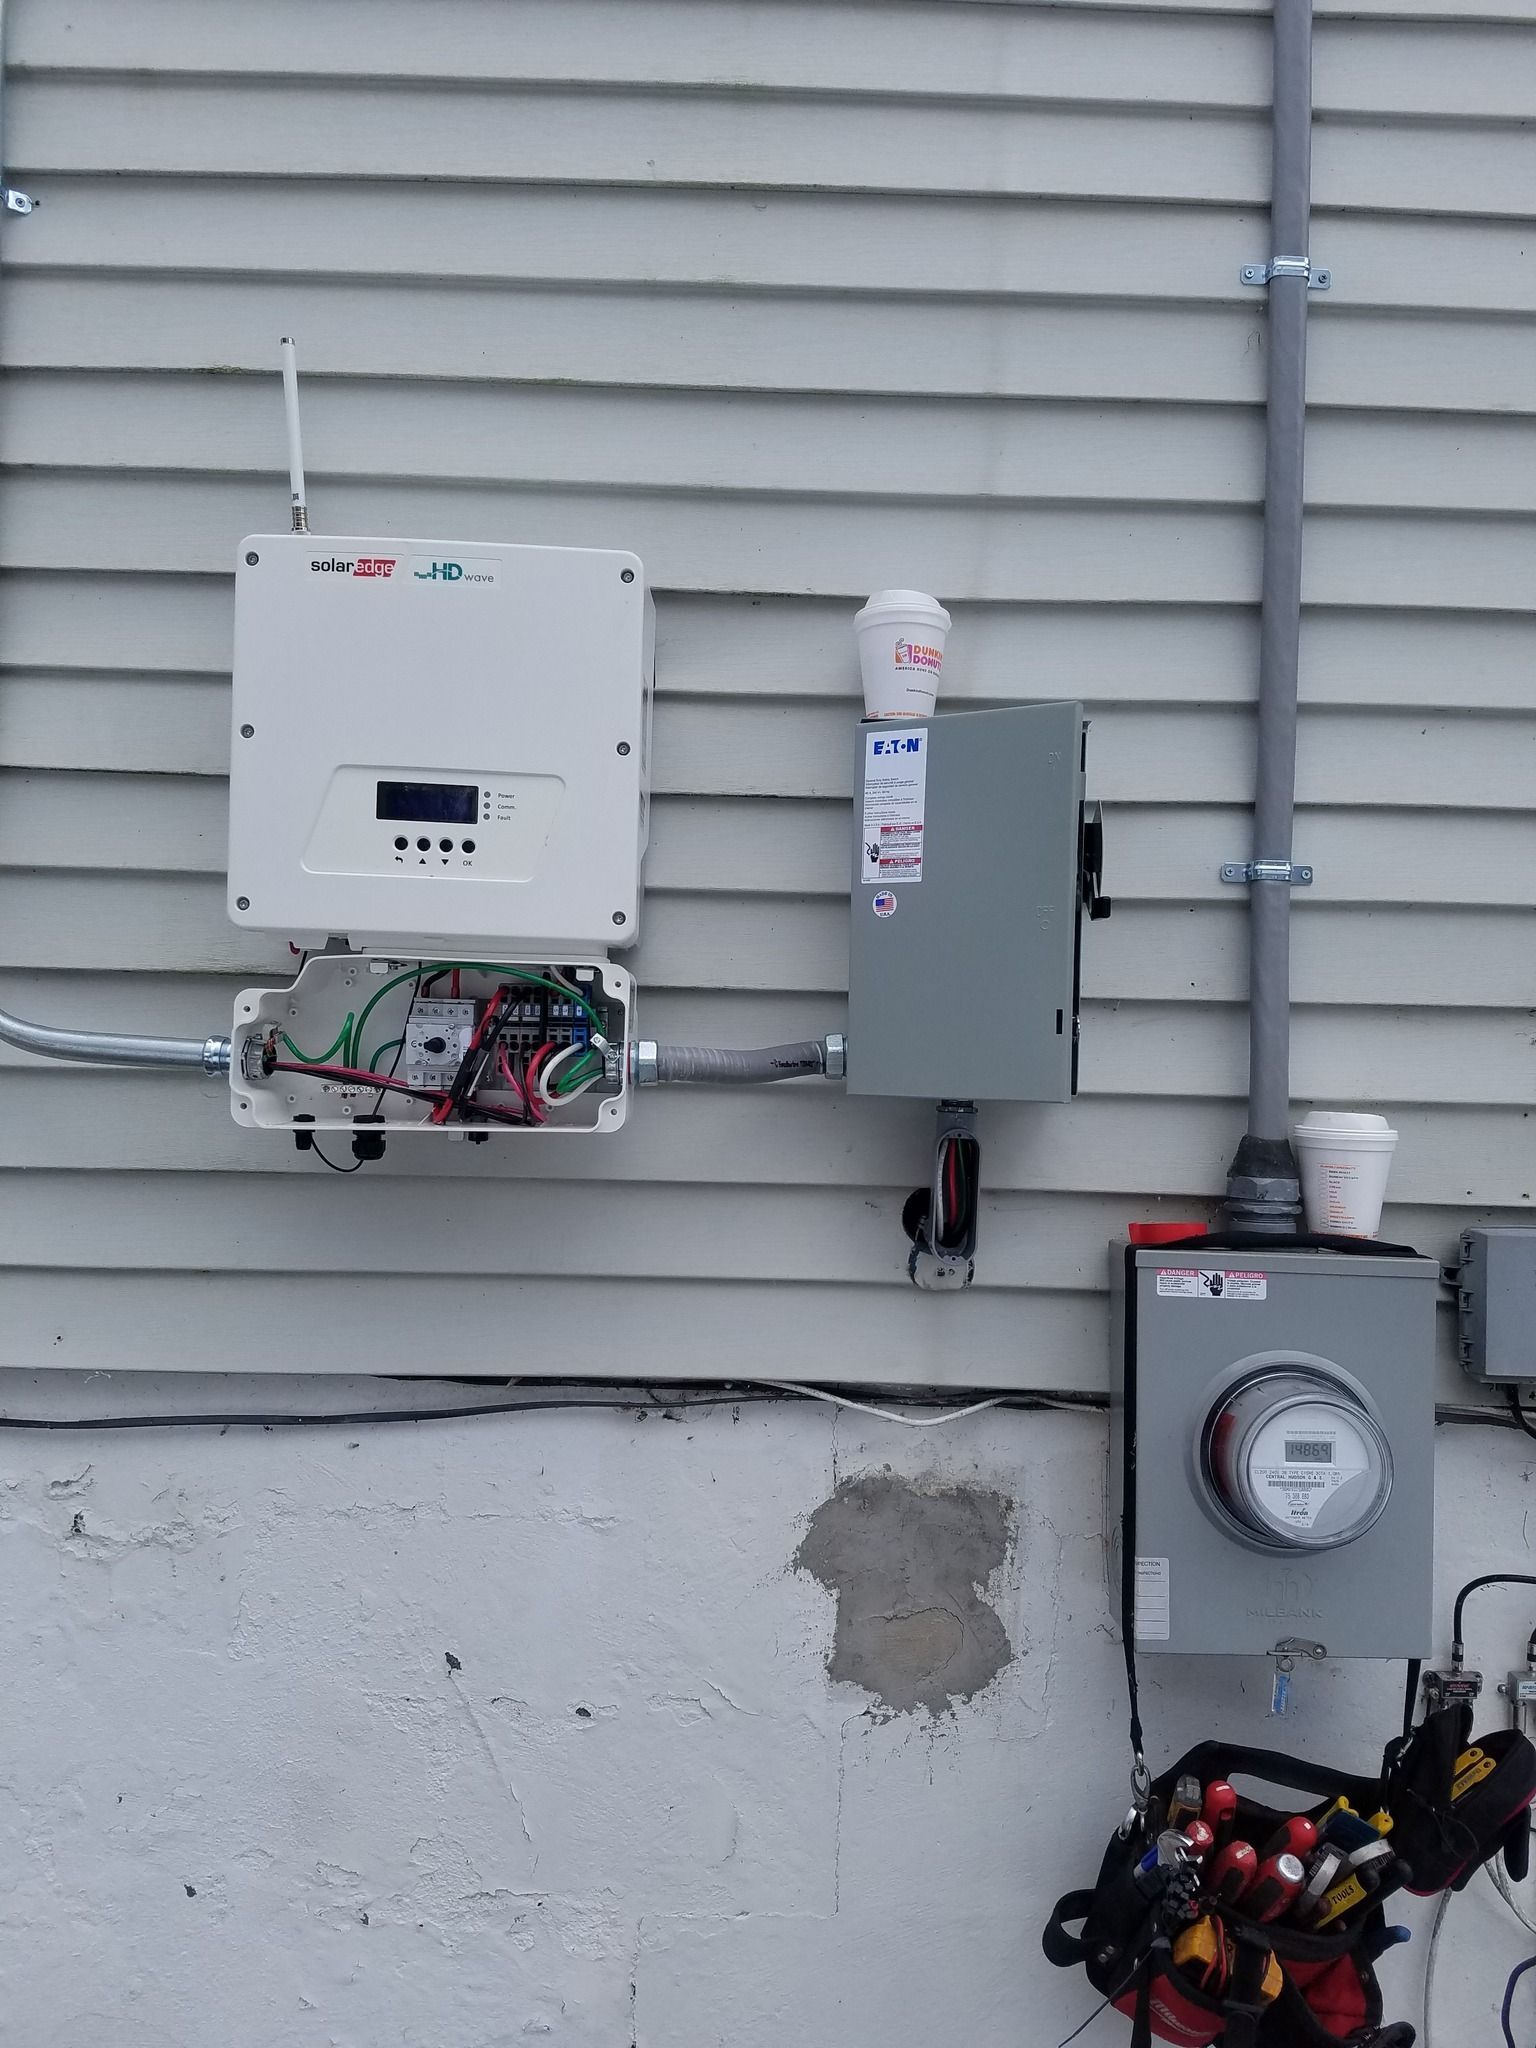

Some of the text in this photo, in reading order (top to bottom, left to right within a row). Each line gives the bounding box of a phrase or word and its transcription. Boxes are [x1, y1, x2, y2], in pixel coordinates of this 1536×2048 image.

[311, 558, 395, 577] solaredge
[873, 738, 920, 755] EATON
[1290, 1508, 1309, 1516] Itron
[1246, 1607, 1327, 1619] MILBANK
[1331, 1884, 1355, 1905] TOOLS
